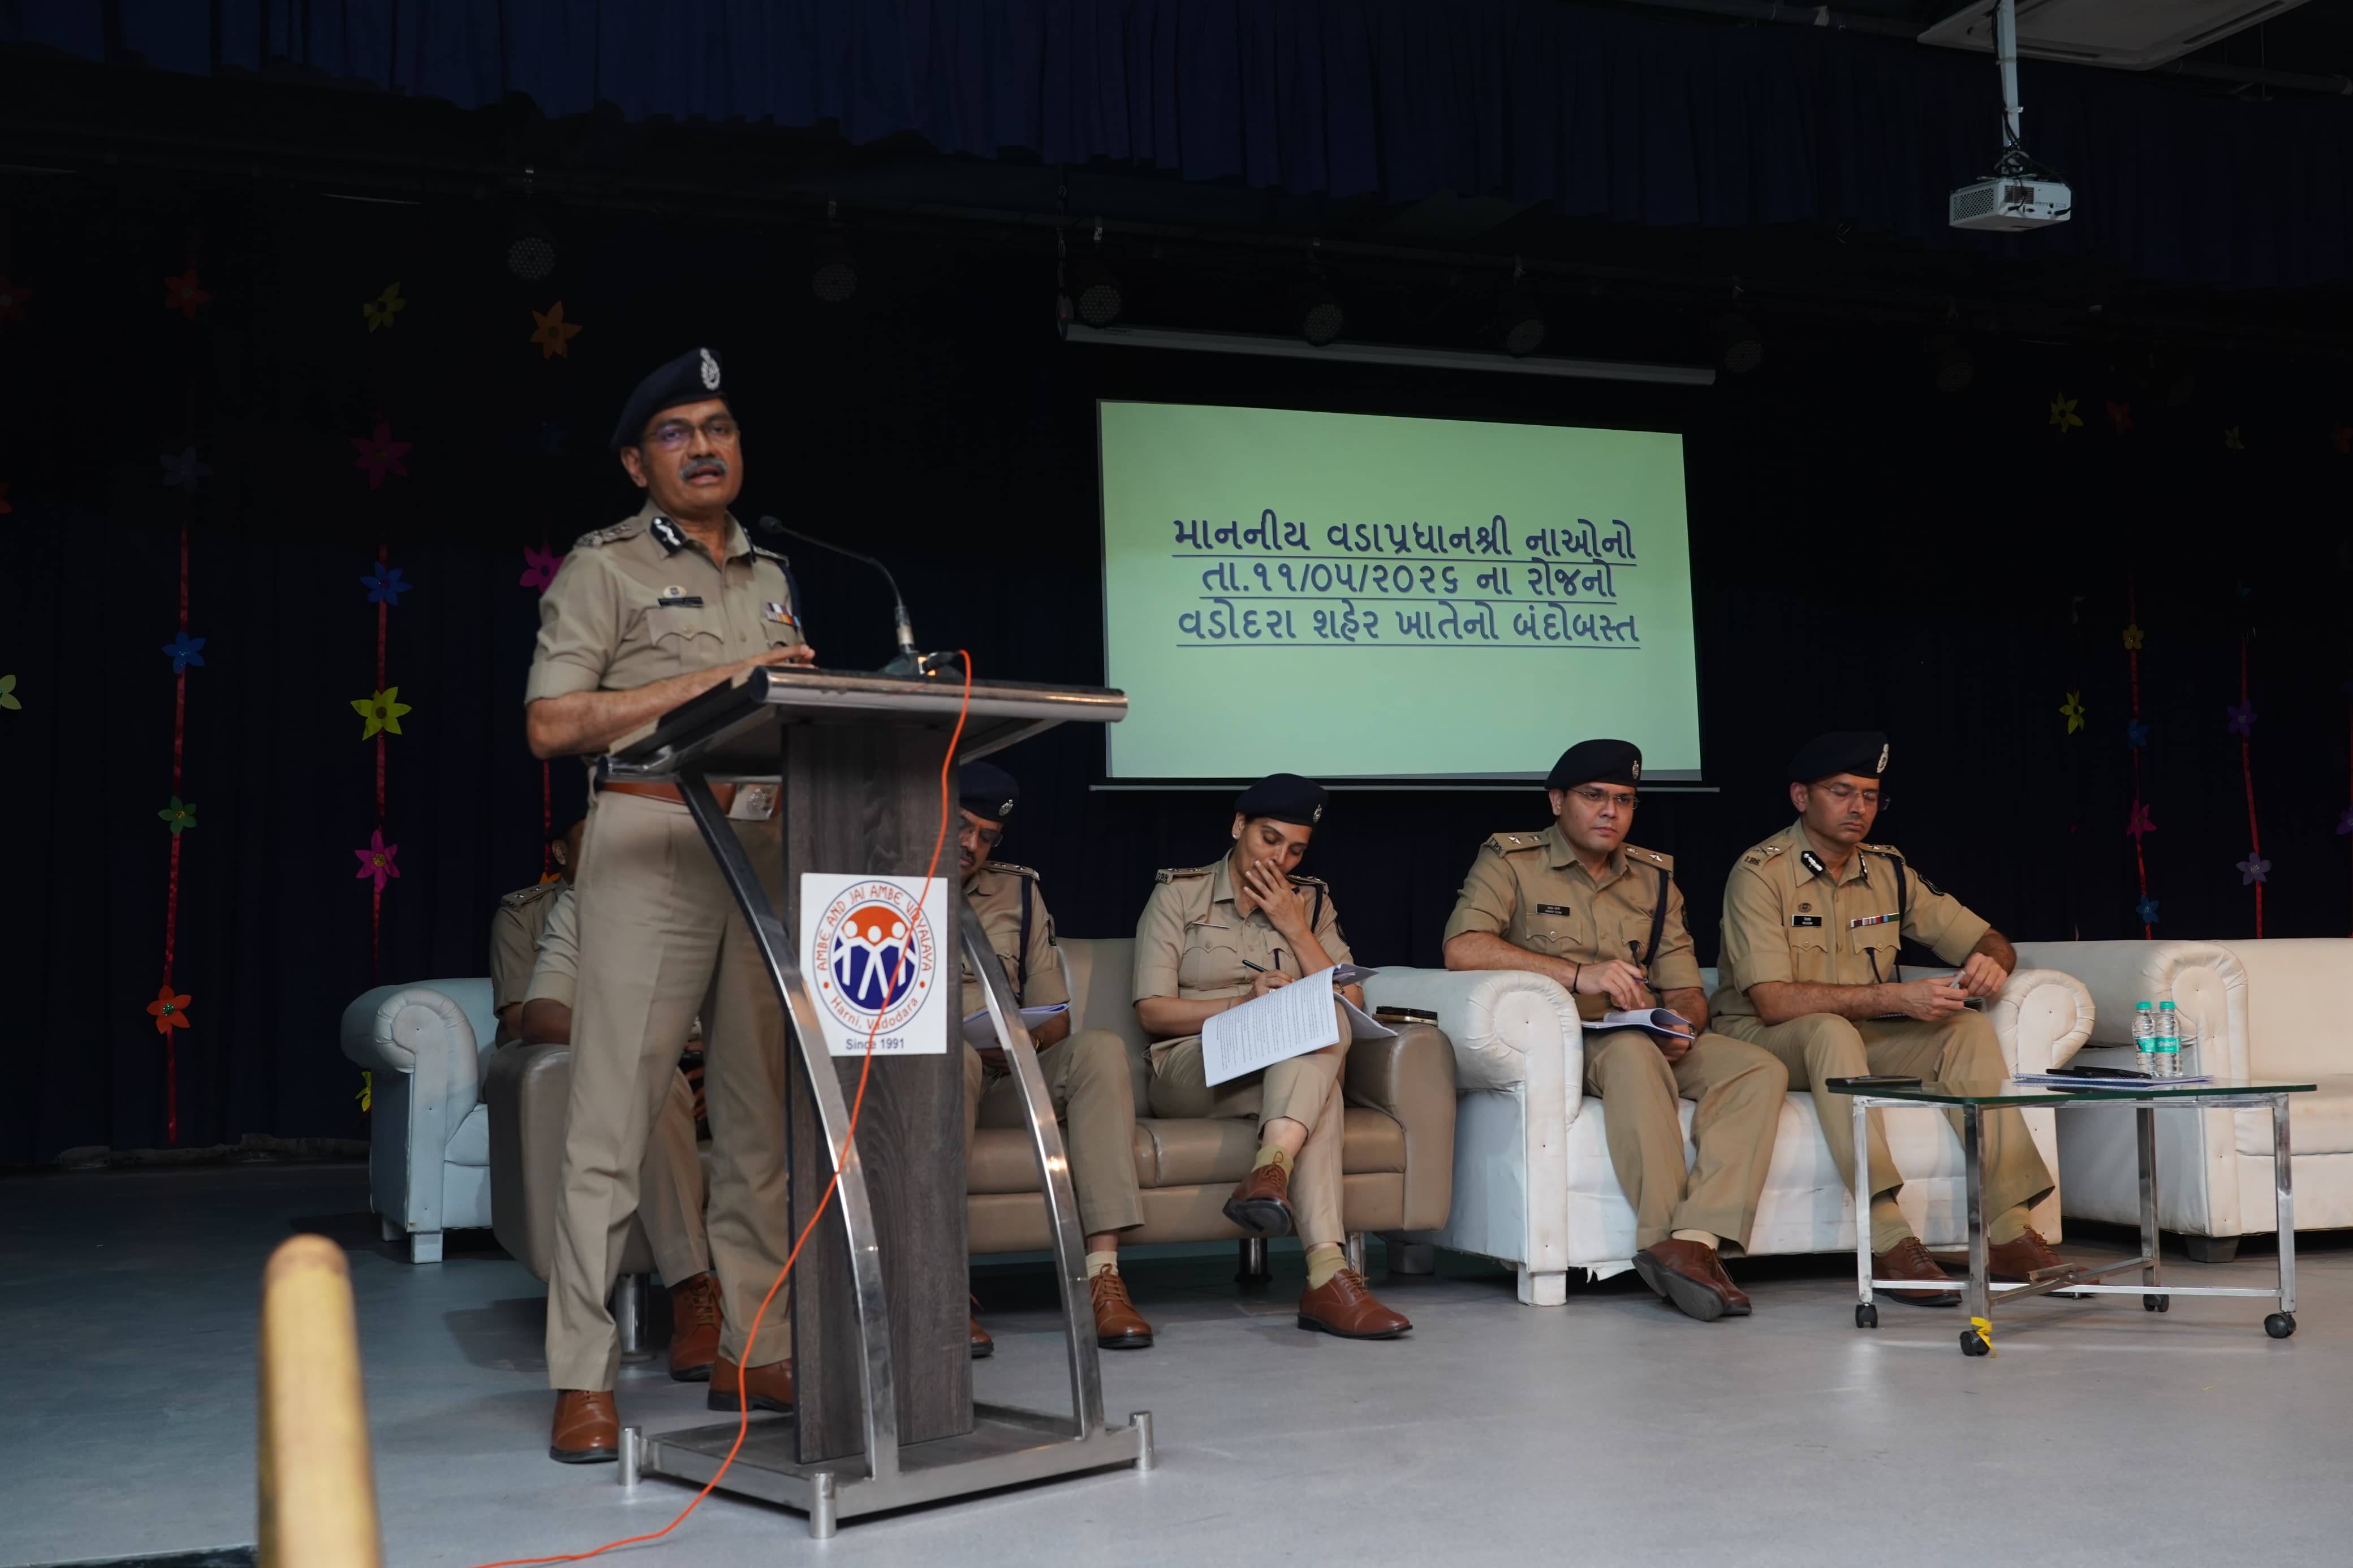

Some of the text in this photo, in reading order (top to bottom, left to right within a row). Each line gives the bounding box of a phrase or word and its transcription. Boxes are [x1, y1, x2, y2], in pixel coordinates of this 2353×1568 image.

[1173, 508, 1636, 559] માનનીય વડાપ્રધાનશ્રી નાઓનો
[1202, 557, 1617, 597] તા.૧૧/૦૫/૨૦૨૬ ના રોજનો
[1179, 598, 1640, 642] વડોદરા શહેર ખાતેનો બંદોબસ્ત
[817, 929, 831, 971] AMBE
[826, 901, 846, 927] AND
[849, 886, 865, 905] JAI
[870, 885, 903, 905] AMBE
[830, 996, 862, 1029] Harni,
[881, 1038, 904, 1049] 1991
